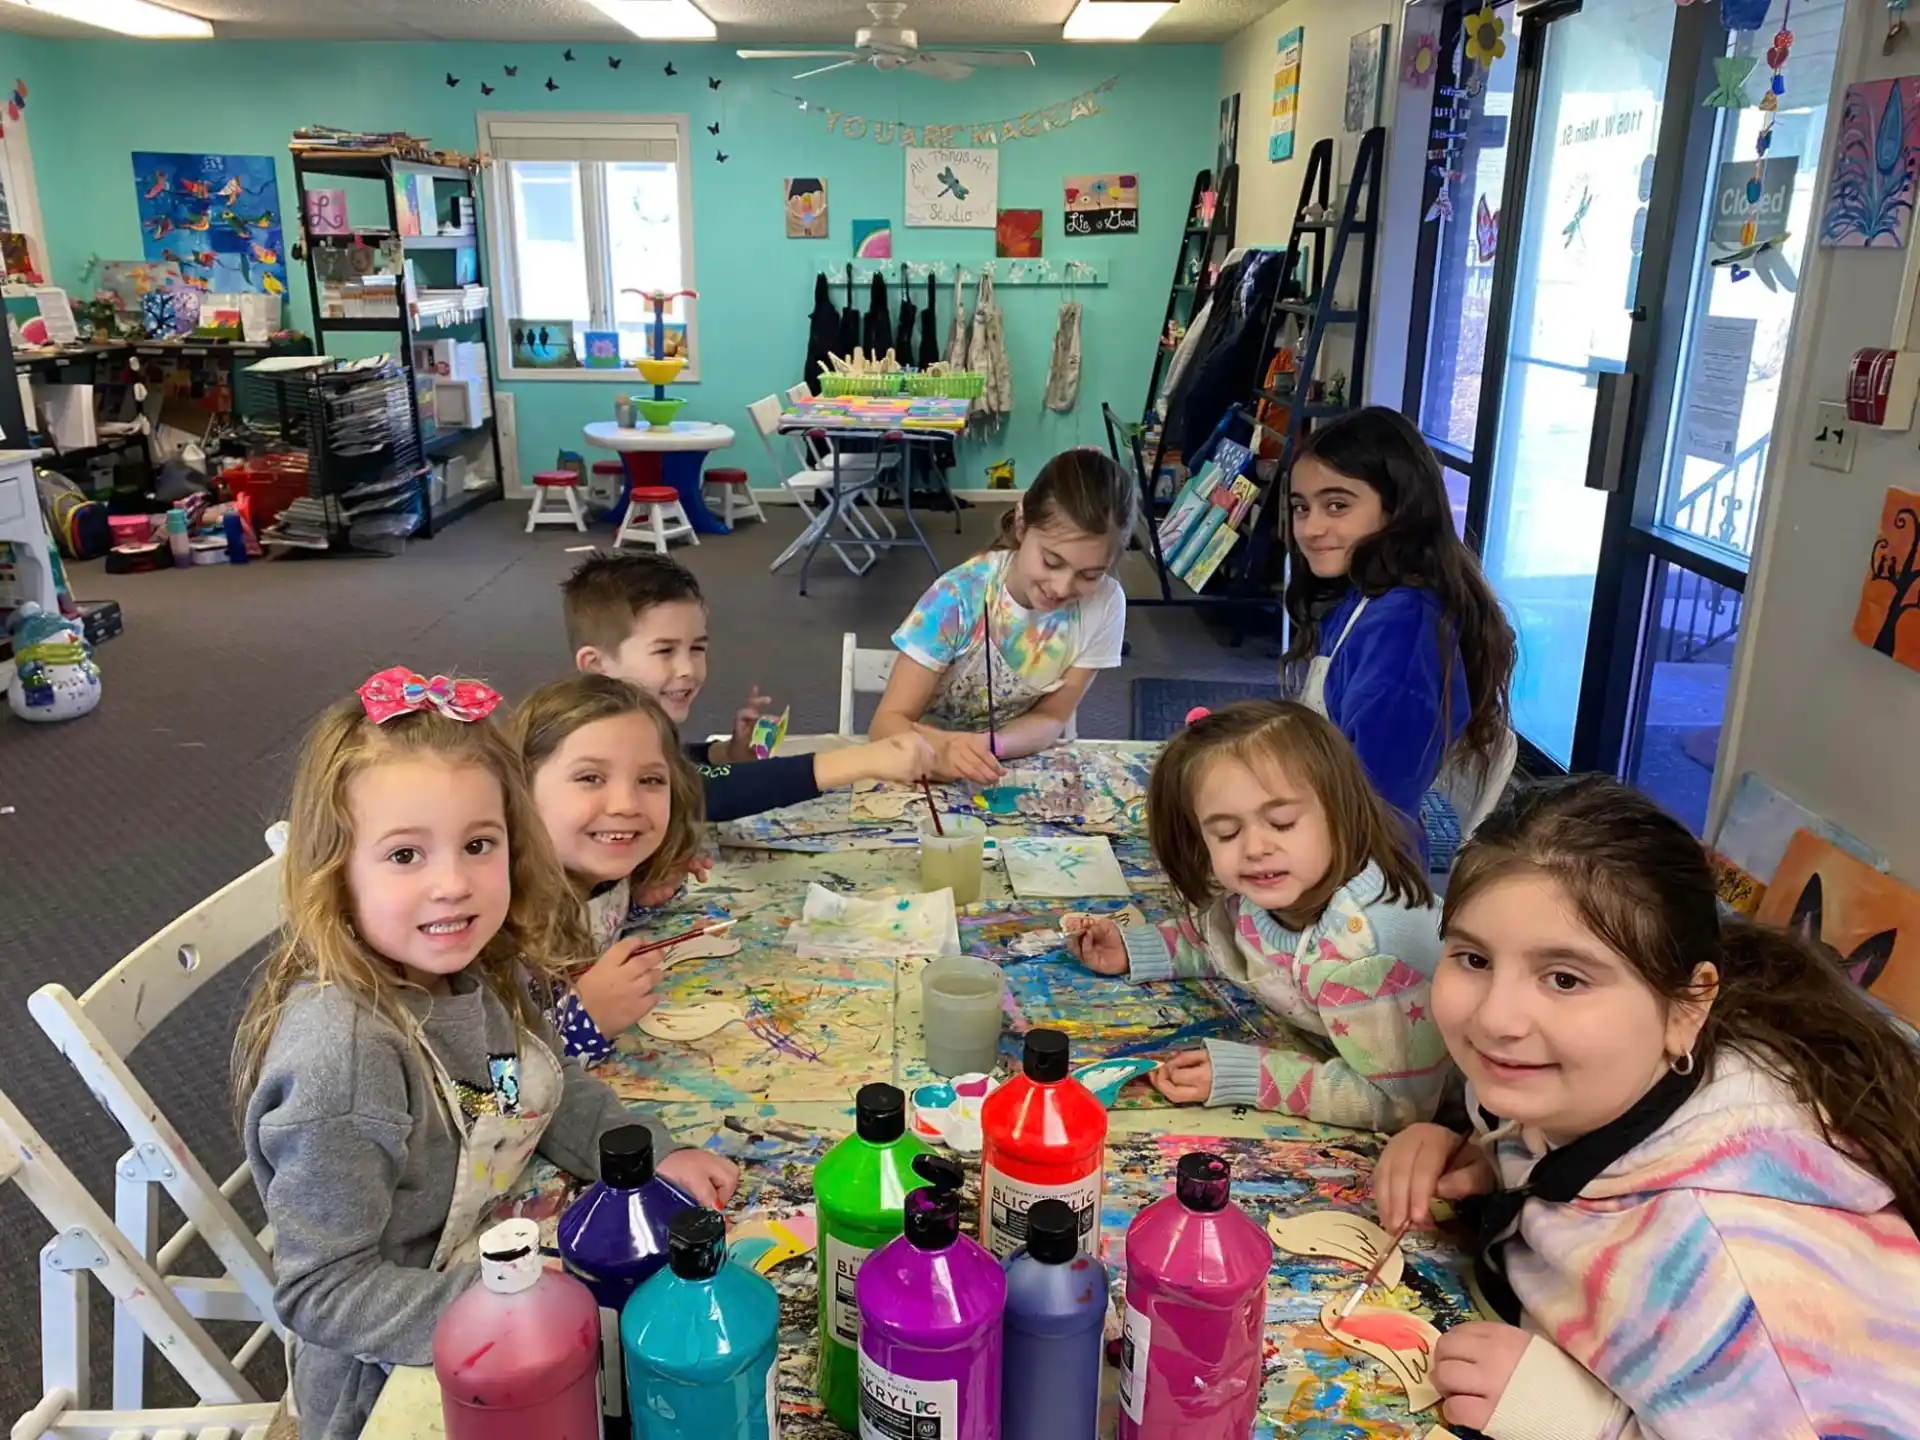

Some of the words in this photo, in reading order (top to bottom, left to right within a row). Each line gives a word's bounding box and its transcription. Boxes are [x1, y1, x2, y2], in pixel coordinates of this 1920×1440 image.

[824, 108, 895, 145] YOU
[911, 157, 928, 174] All
[1720, 185, 1786, 216] Cloed
[929, 203, 973, 223] Studio
[1104, 210, 1137, 230] Good
[993, 1186, 1094, 1212] BLICLIC
